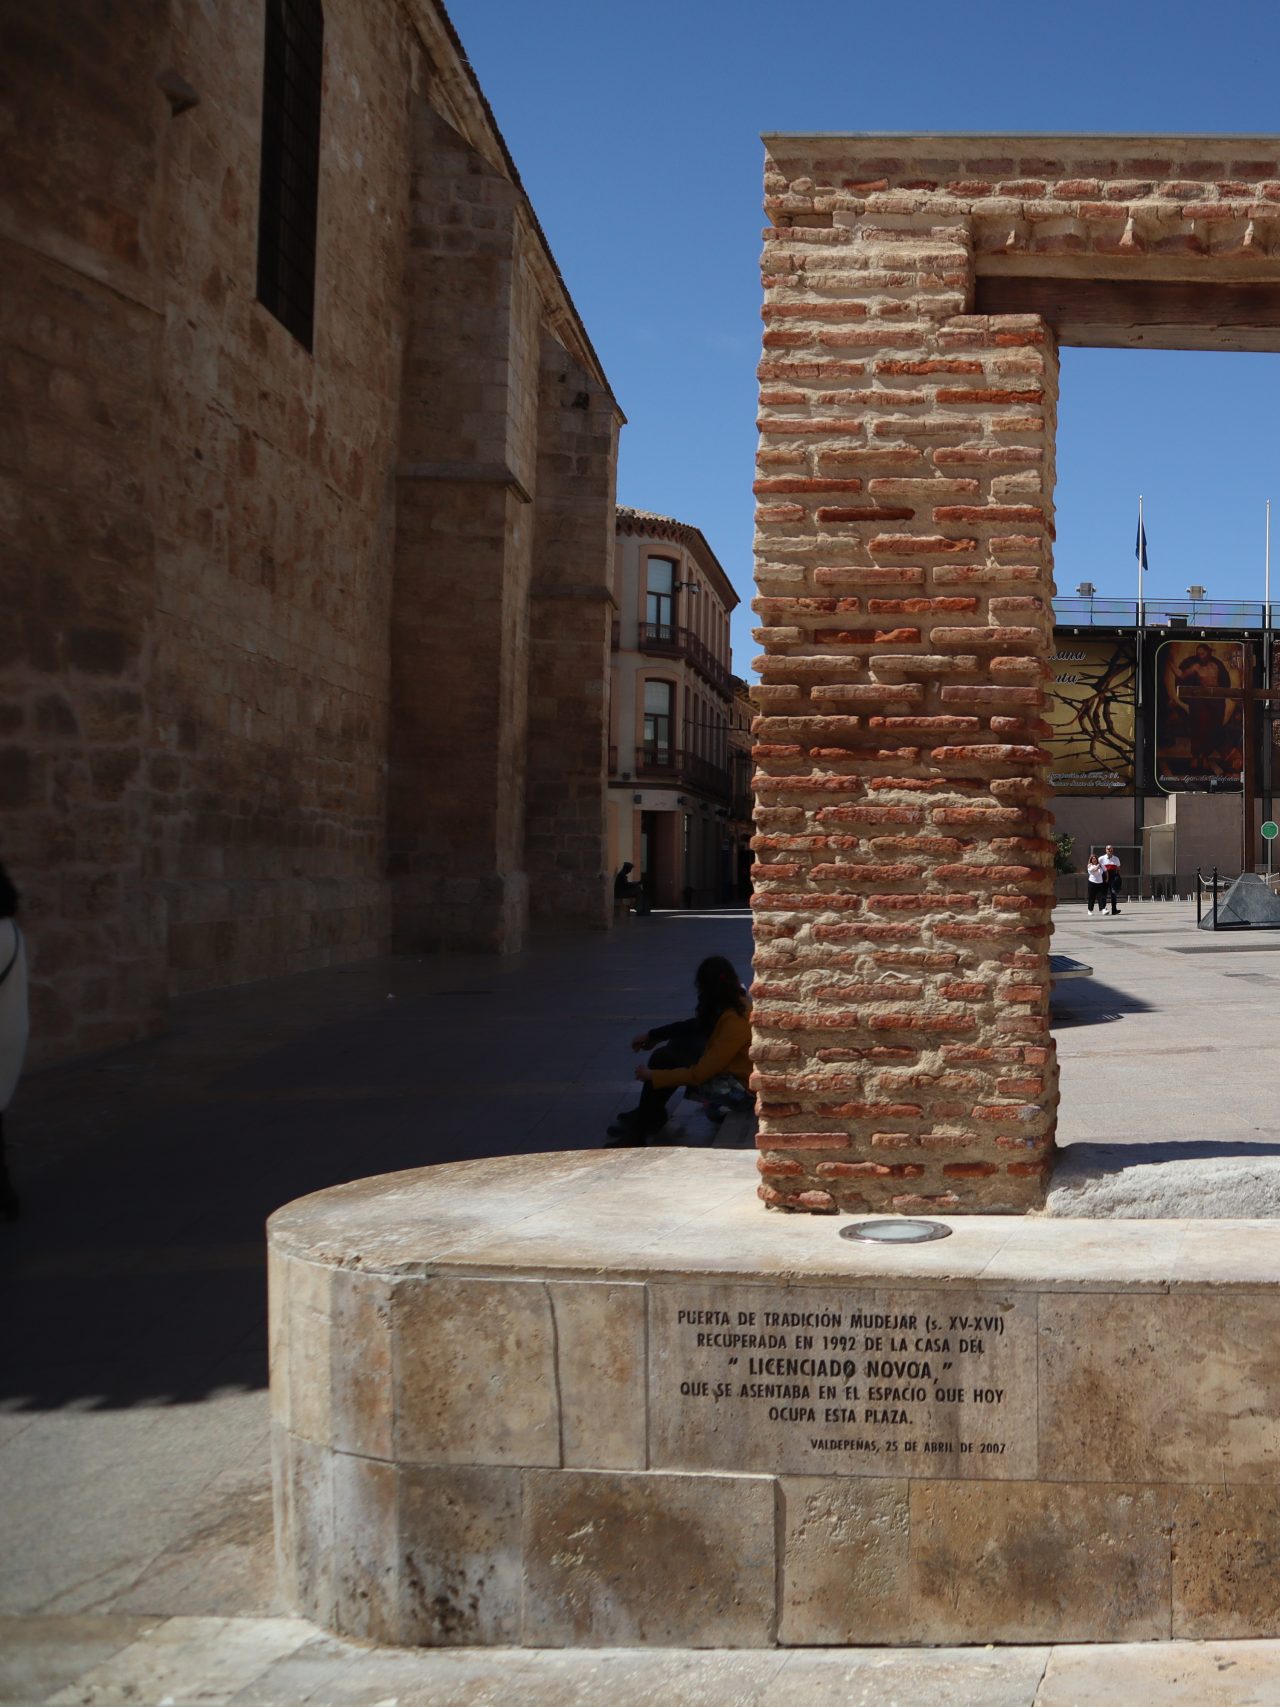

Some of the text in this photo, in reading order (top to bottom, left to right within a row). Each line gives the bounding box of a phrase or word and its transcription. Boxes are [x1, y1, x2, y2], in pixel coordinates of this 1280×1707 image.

[678, 1308, 1004, 1335] PUERTA DE TRADICIÓN MUDEJAR (s. XV-XVI)
[697, 1333, 984, 1354] RECUPERADA EN 1992 DE LA CASA DEL
[749, 1358, 855, 1378] LICENCIADO
[681, 1382, 1004, 1404] QUE SE ASENTABA EN EL ESPACIO QUE HOY
[769, 1406, 913, 1424] OCUPA ESTA PLAZA.
[811, 1438, 1005, 1454] VALDEPEÑAS, 25 DE ABRIL DE 2007
